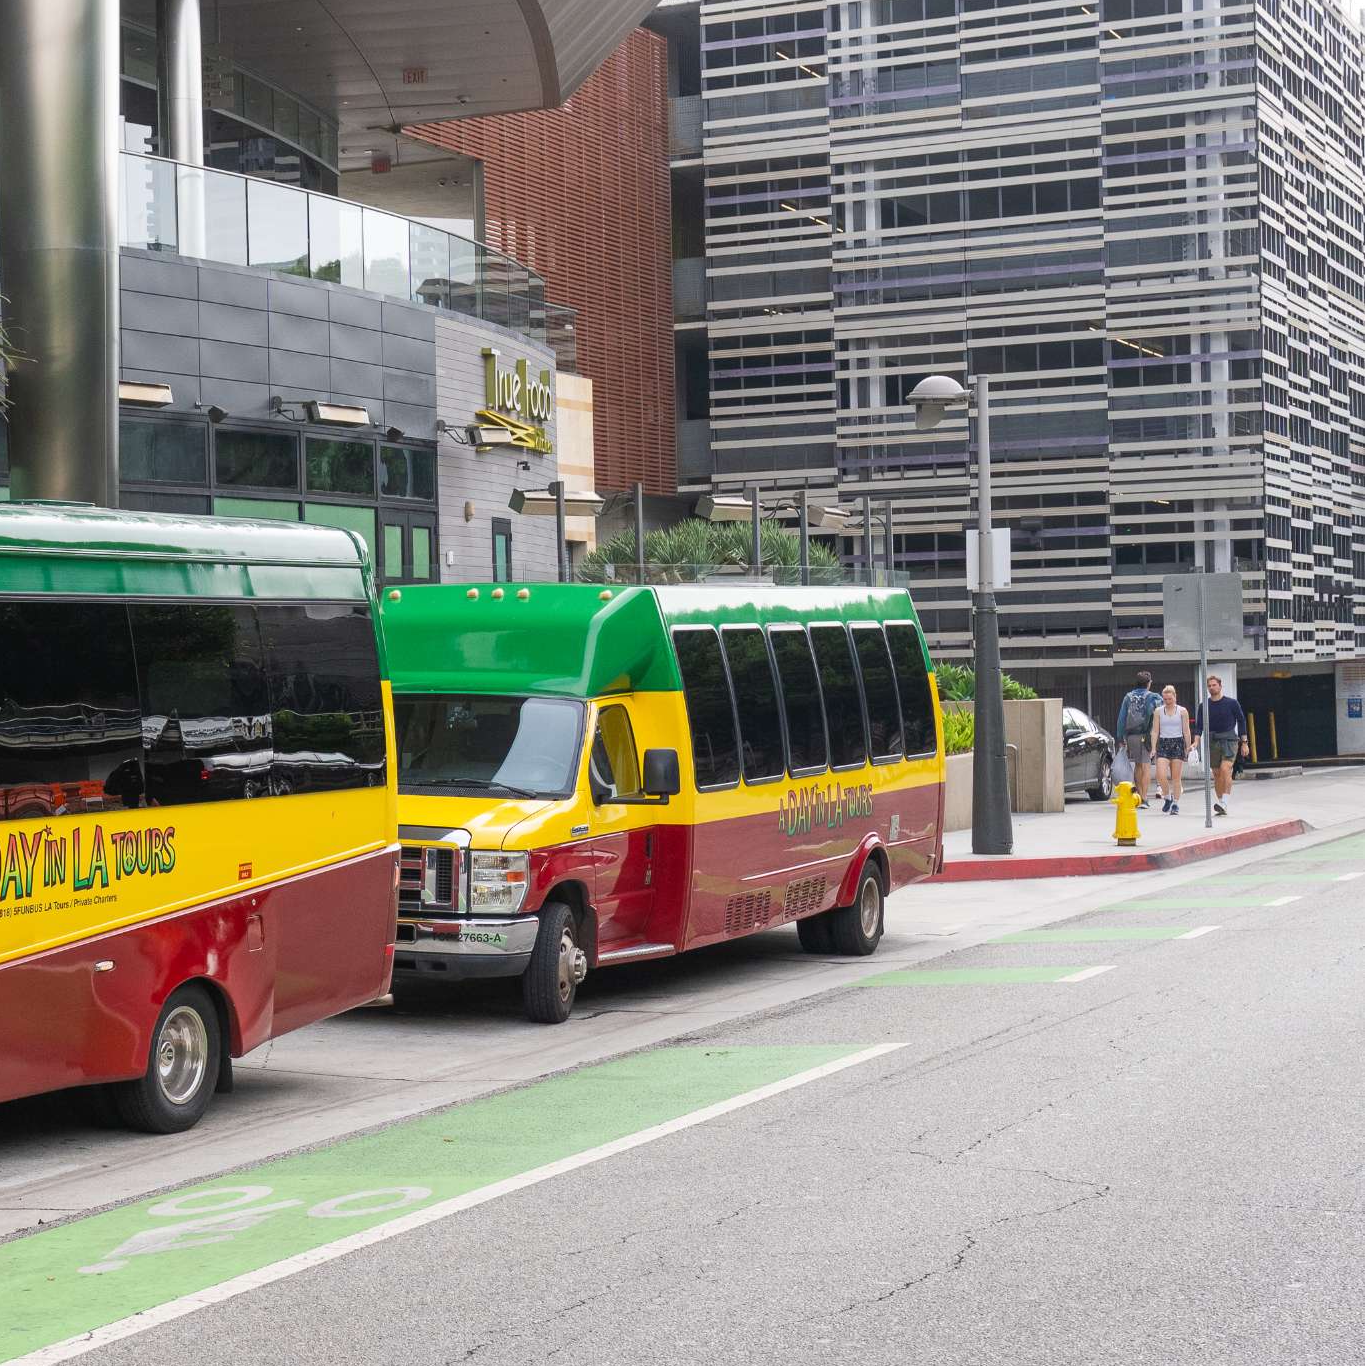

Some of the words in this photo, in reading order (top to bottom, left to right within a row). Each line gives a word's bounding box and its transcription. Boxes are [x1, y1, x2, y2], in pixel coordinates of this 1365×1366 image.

[484, 347, 522, 412] True
[519, 359, 552, 422] Food
[778, 798, 786, 834] A
[787, 787, 815, 836] DAY
[827, 782, 843, 829] LA
[843, 784, 873, 819] TOURS
[73, 825, 110, 892] LA
[111, 827, 176, 880] TOURS
[44, 902, 52, 912] LA
[54, 899, 69, 910] Tours
[73, 897, 93, 907] Private
[93, 894, 117, 905] Charters
[458, 933, 501, 942] 27663-A
